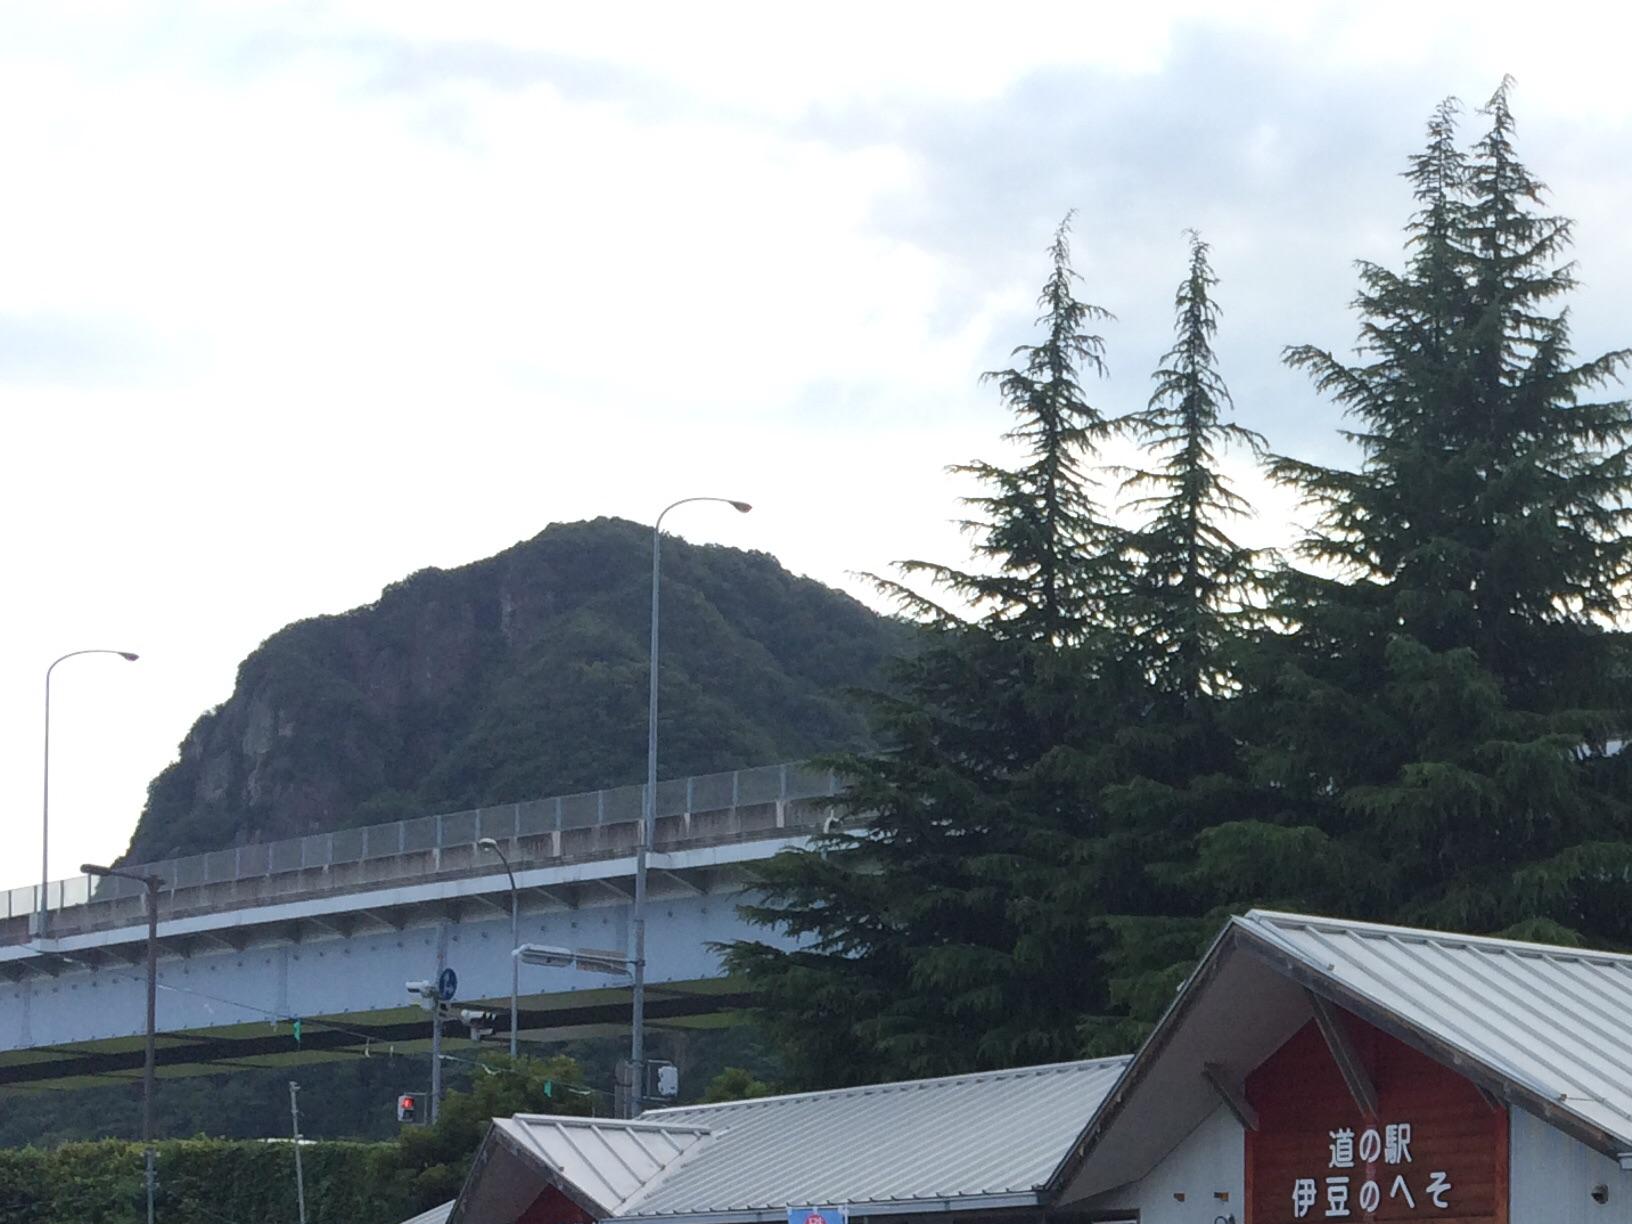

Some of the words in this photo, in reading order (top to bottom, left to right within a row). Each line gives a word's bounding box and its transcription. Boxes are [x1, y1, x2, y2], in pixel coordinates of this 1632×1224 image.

[1328, 1122, 1412, 1169] 道の駅
[1291, 1171, 1452, 1218] 伊豆のへそ
